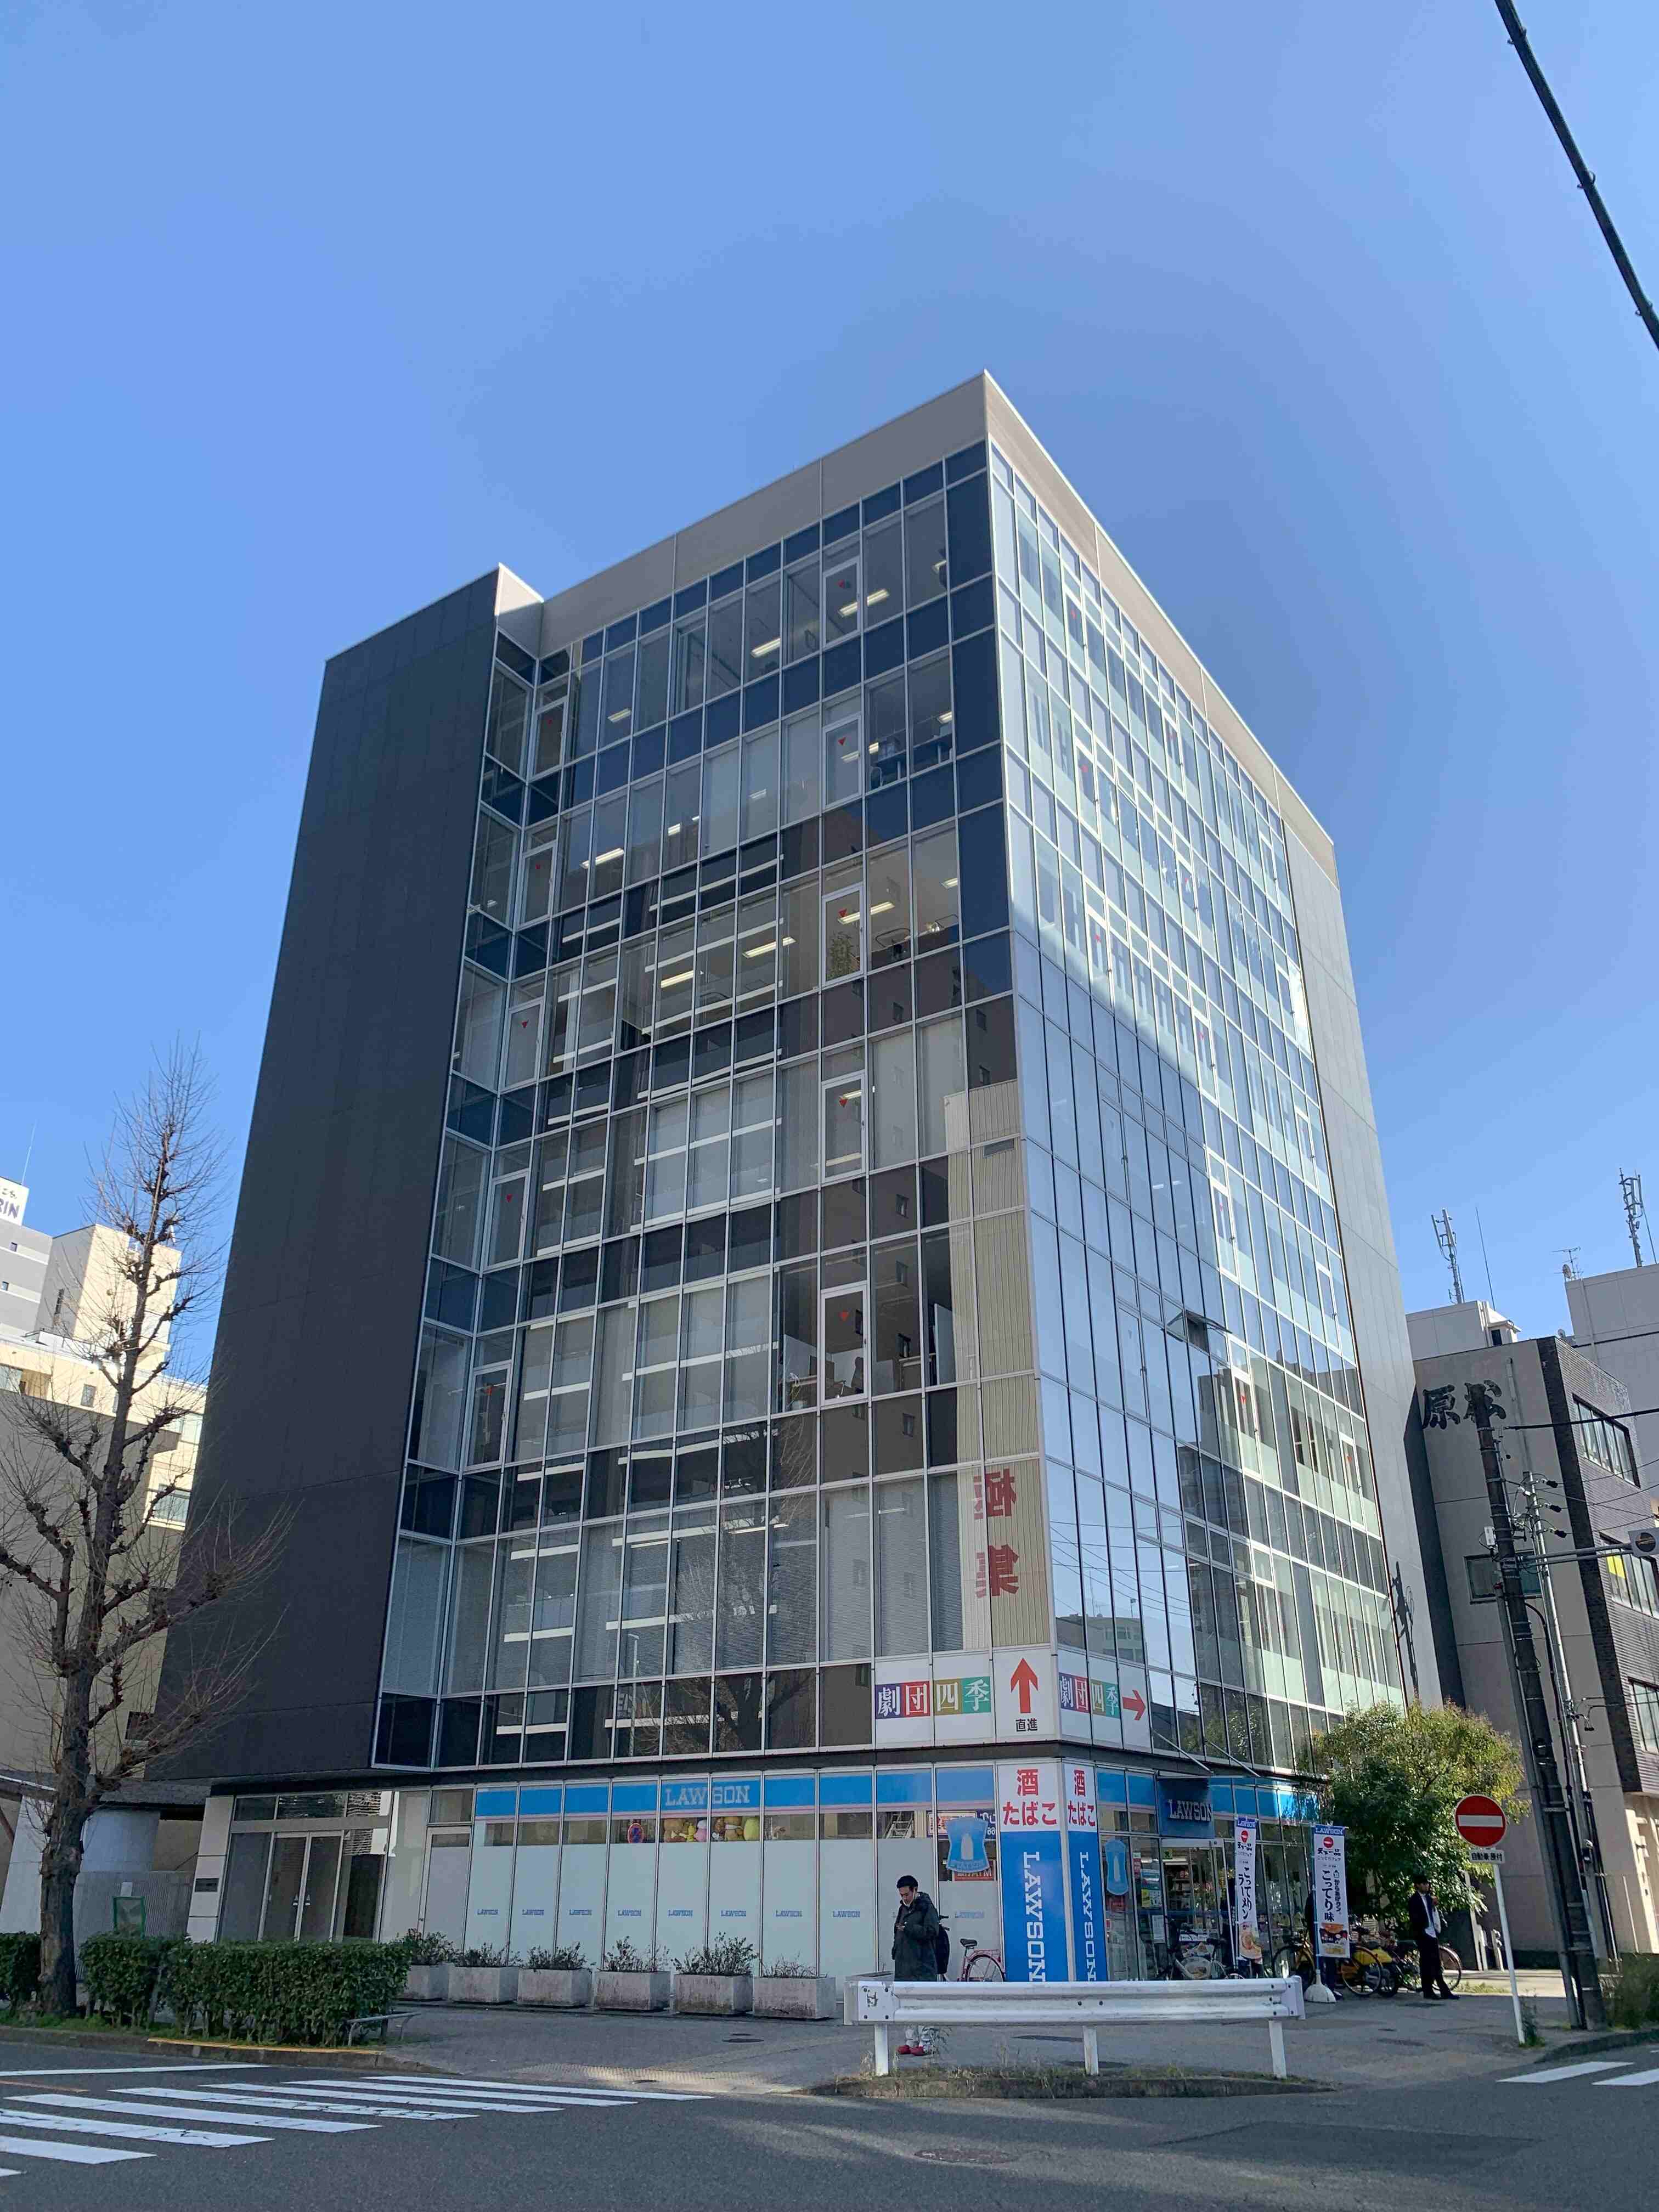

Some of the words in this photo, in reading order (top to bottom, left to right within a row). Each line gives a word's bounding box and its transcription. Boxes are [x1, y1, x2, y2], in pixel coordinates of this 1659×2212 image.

[877, 1679, 990, 1717] 劇団四季
[1060, 1675, 1119, 1716] 劇団四季
[1015, 1718, 1038, 1732] 直進
[665, 1785, 751, 1806] LAWSON
[1017, 1769, 1039, 1796] 酒
[1074, 1769, 1086, 1797] 酒
[1002, 1801, 1057, 1826] たばこ
[1068, 1800, 1096, 1826] たばこ
[1167, 1799, 1212, 1821] LAWSON
[1322, 1870, 1335, 1922] こってり味
[1023, 1851, 1046, 1982] LAWSON
[1079, 1851, 1097, 1982] LAWSON
